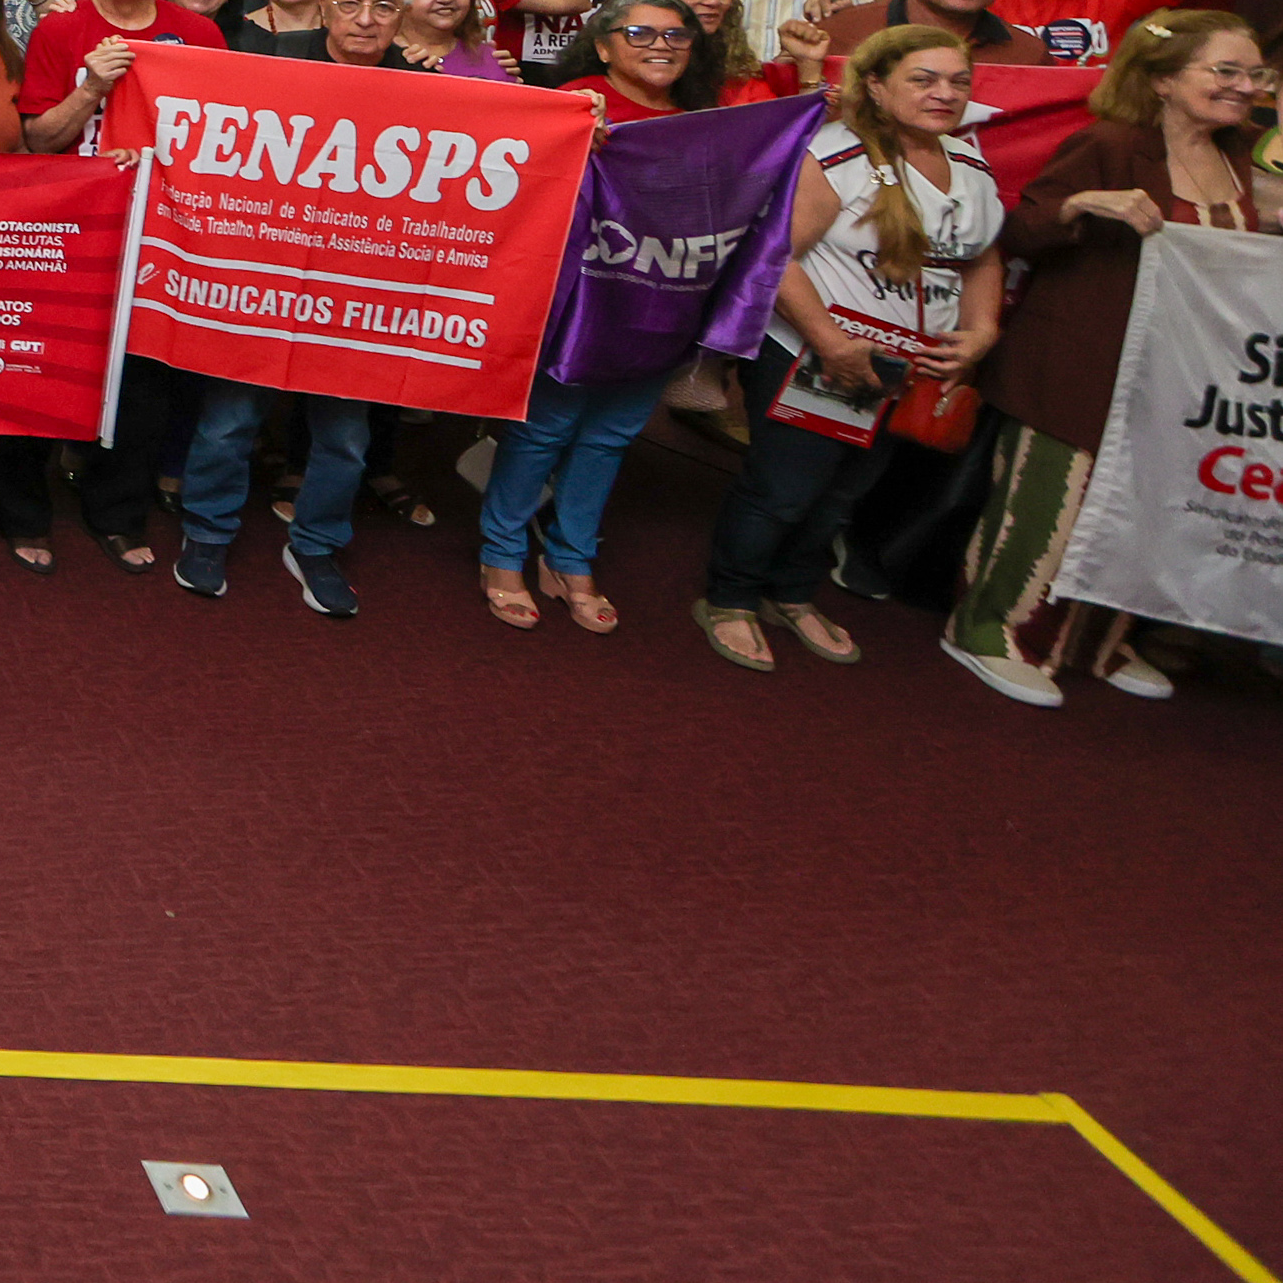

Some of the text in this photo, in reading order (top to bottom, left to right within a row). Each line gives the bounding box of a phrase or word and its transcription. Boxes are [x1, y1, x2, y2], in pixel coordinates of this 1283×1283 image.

[153, 95, 530, 211] FENASPS
[206, 215, 256, 241] Trabalho,
[258, 223, 326, 250] Previdência,
[327, 232, 396, 258] Assistência
[398, 240, 434, 262] Social
[436, 251, 445, 263] e
[445, 246, 489, 269] Anvisa
[219, 192, 272, 215] Nacional
[280, 200, 295, 219] de
[302, 204, 368, 229] Sindicatos
[376, 214, 392, 233] de
[401, 216, 494, 245] Trabalhadores
[5, 259, 67, 273] AMANHÃ!
[164, 268, 334, 325] SINDICATOS
[341, 300, 488, 348] FILIADOS
